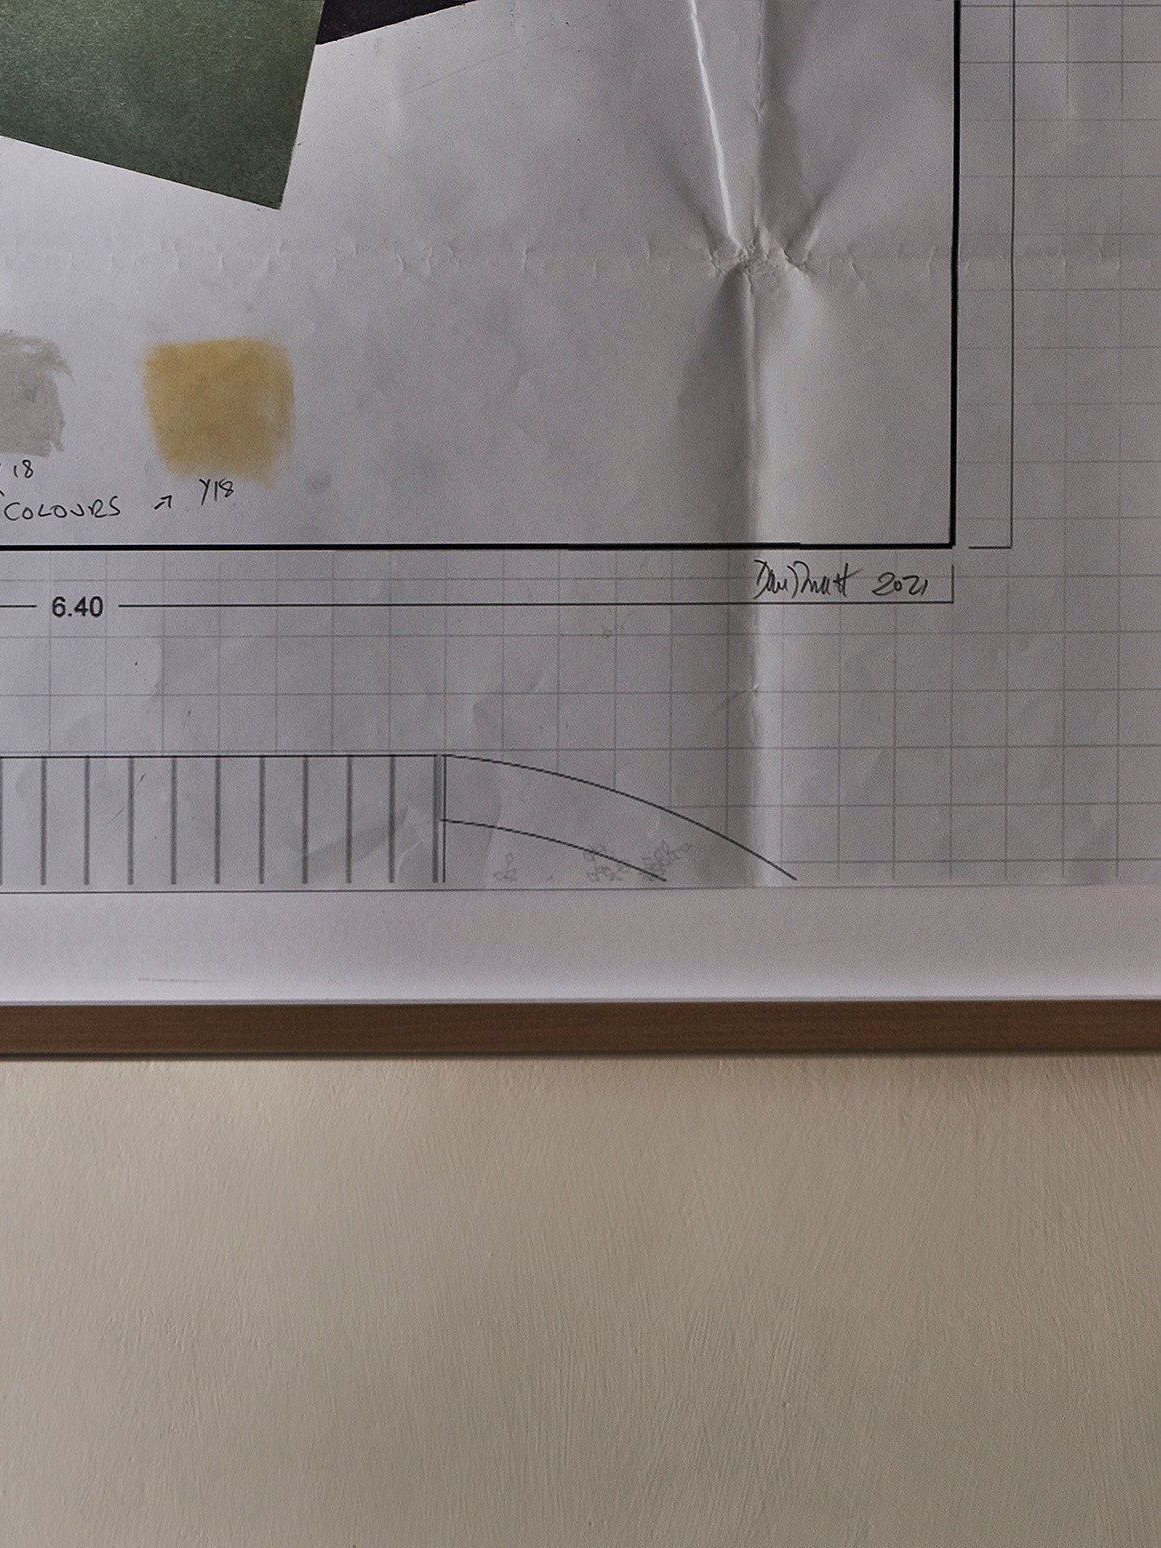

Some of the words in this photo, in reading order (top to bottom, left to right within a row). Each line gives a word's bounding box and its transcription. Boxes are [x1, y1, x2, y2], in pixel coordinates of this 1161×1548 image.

[13, 459, 34, 479] 18
[3, 495, 122, 522] COLOURS
[872, 571, 929, 596] 2021
[52, 595, 104, 618] 6.40
